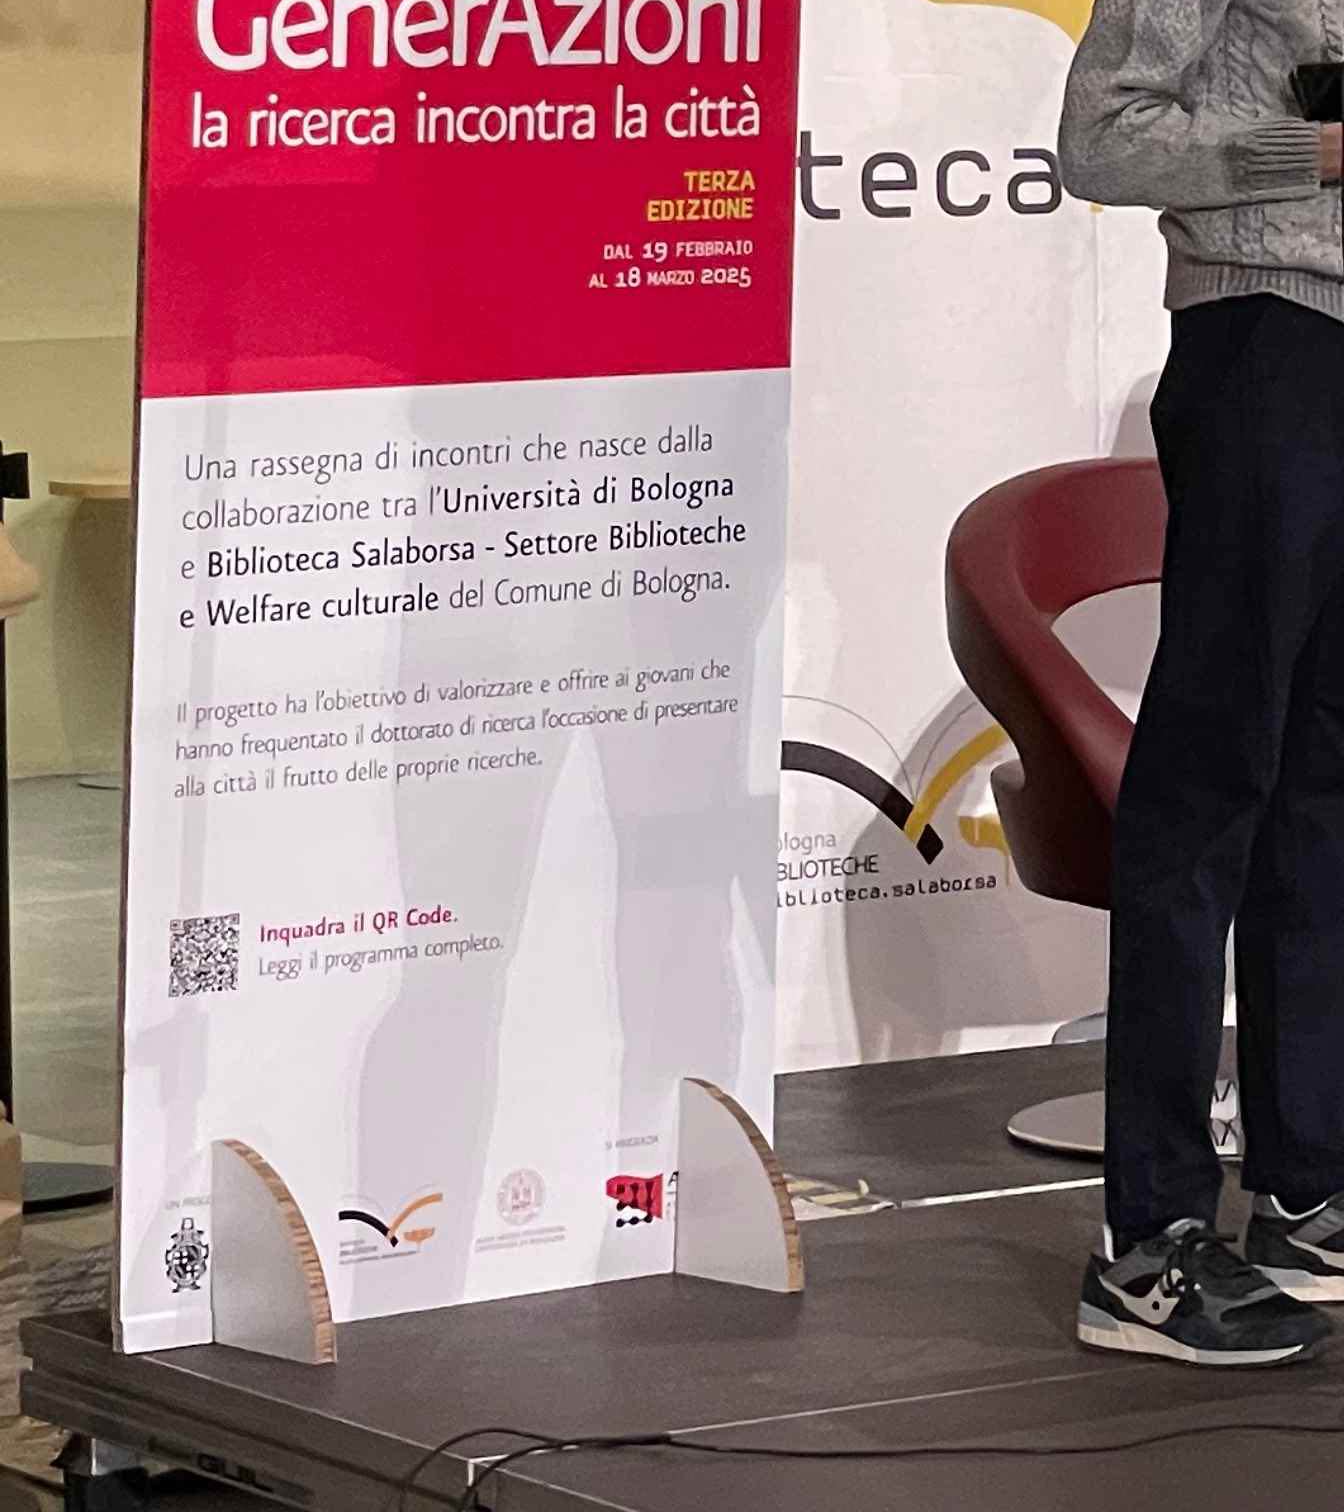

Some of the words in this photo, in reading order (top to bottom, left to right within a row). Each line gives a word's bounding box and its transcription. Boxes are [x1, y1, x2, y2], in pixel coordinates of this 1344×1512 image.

[192, 91, 227, 148] la
[248, 94, 395, 147] ricerca
[417, 91, 596, 143] incontra
[615, 86, 649, 139] la
[665, 84, 760, 138] città
[683, 169, 755, 192] TERZA
[647, 197, 753, 222] EDIZIONE
[603, 243, 634, 260] DAL
[642, 241, 668, 263] 19
[675, 239, 753, 258] FEBBRAIO
[588, 273, 608, 289] AL
[615, 266, 641, 288] 18
[647, 269, 695, 286] MARZO
[701, 266, 752, 288] 2025
[184, 453, 237, 481] Una
[251, 451, 363, 485] rassegna
[376, 441, 398, 470] di
[411, 436, 511, 469] incontri
[523, 432, 567, 462] che
[579, 436, 647, 459] nasce
[658, 424, 713, 454] dalla
[182, 495, 370, 530] collaborazione
[382, 496, 417, 518] tra
[593, 475, 617, 504] di
[631, 472, 733, 509] Bologna
[181, 559, 195, 580] e
[208, 545, 339, 578] Biblioteca
[351, 536, 475, 568] Salaborsa
[504, 530, 598, 558] Settore
[610, 515, 746, 550] Biblioteche
[180, 609, 195, 628] e
[207, 593, 311, 627] Welfare
[322, 582, 439, 617] culturale
[449, 579, 484, 608] del
[495, 579, 592, 606] Comune
[601, 569, 621, 597] di
[633, 566, 730, 603] Bologna.
[177, 702, 187, 723] Il
[195, 701, 277, 728] progetto
[285, 692, 307, 714] ha
[414, 682, 429, 704] di
[437, 677, 533, 701] valorizzare
[540, 678, 551, 693] e
[558, 668, 608, 693] offrire
[615, 667, 629, 688] ai
[635, 662, 695, 693] giovani
[701, 659, 731, 680] che
[176, 740, 233, 761] hanno
[241, 732, 348, 759] frequentato
[355, 724, 364, 745] il
[371, 722, 454, 744] dottorato
[460, 715, 475, 737] di
[482, 713, 535, 734] ricerca
[634, 700, 649, 721] di
[655, 696, 738, 726] presentare
[174, 776, 205, 799] alla
[214, 774, 257, 795] città
[265, 769, 275, 790] il
[283, 764, 338, 788] frutto
[346, 759, 388, 783] delle
[396, 753, 459, 784] proprie
[467, 747, 543, 772] ricerche.
[777, 854, 879, 882] BLIOTECHE
[778, 832, 837, 855] logna
[776, 874, 997, 908] iblioteca.salaborsa
[259, 916, 345, 947] Inquadra
[353, 912, 364, 933] il
[372, 911, 398, 935] QR
[406, 904, 458, 926] Code.
[258, 955, 302, 982] Leggi
[310, 949, 318, 970] il
[324, 944, 418, 975] programma
[425, 933, 504, 961] completo.
